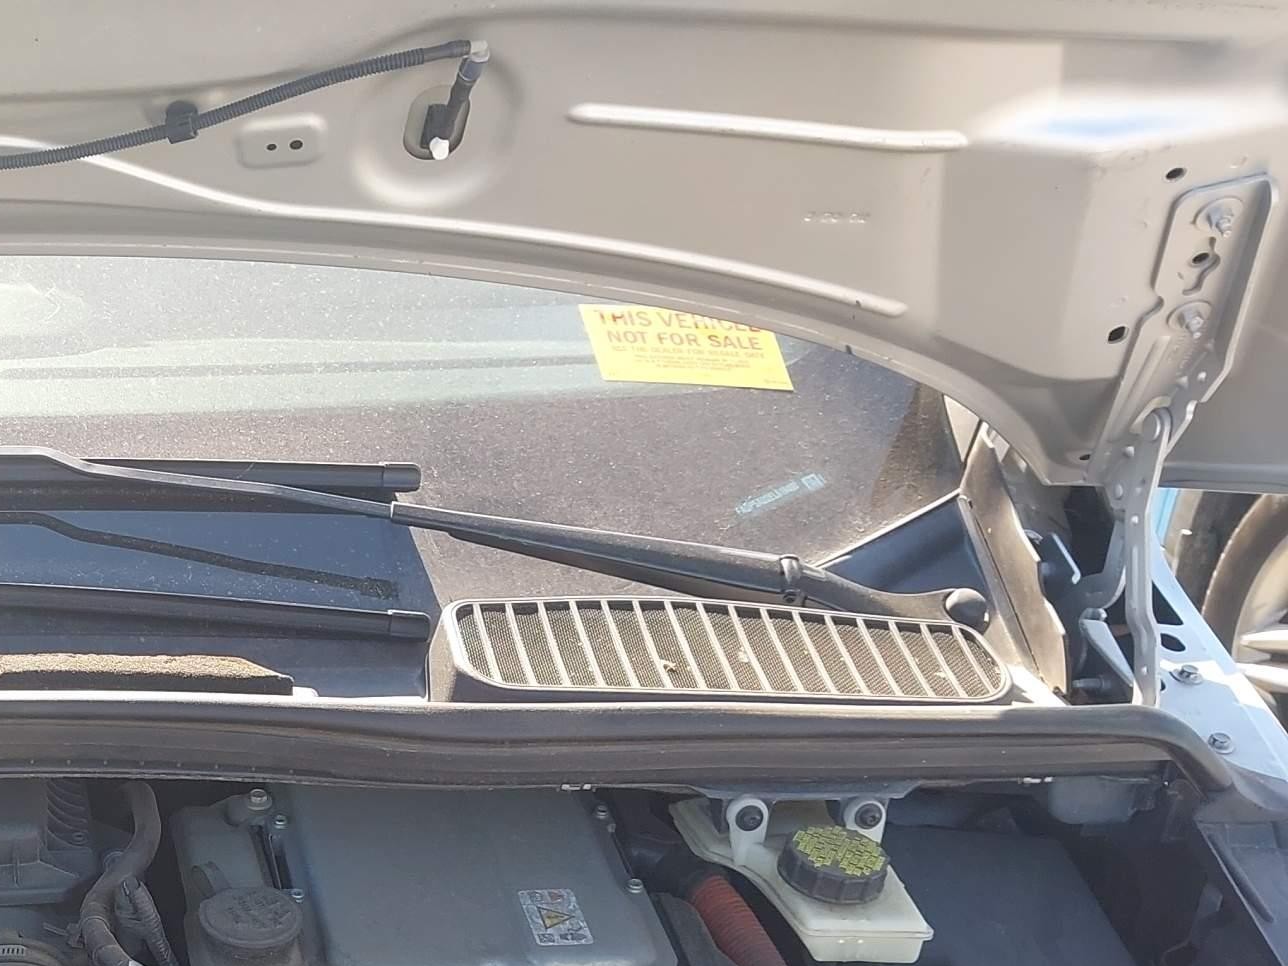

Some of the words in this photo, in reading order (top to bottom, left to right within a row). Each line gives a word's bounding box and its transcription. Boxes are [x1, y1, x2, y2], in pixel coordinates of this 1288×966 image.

[593, 309, 652, 327] THIS
[656, 311, 760, 332] VEHICL
[608, 330, 648, 344] NOT
[657, 332, 700, 346] FOR
[708, 335, 762, 350] SALE
